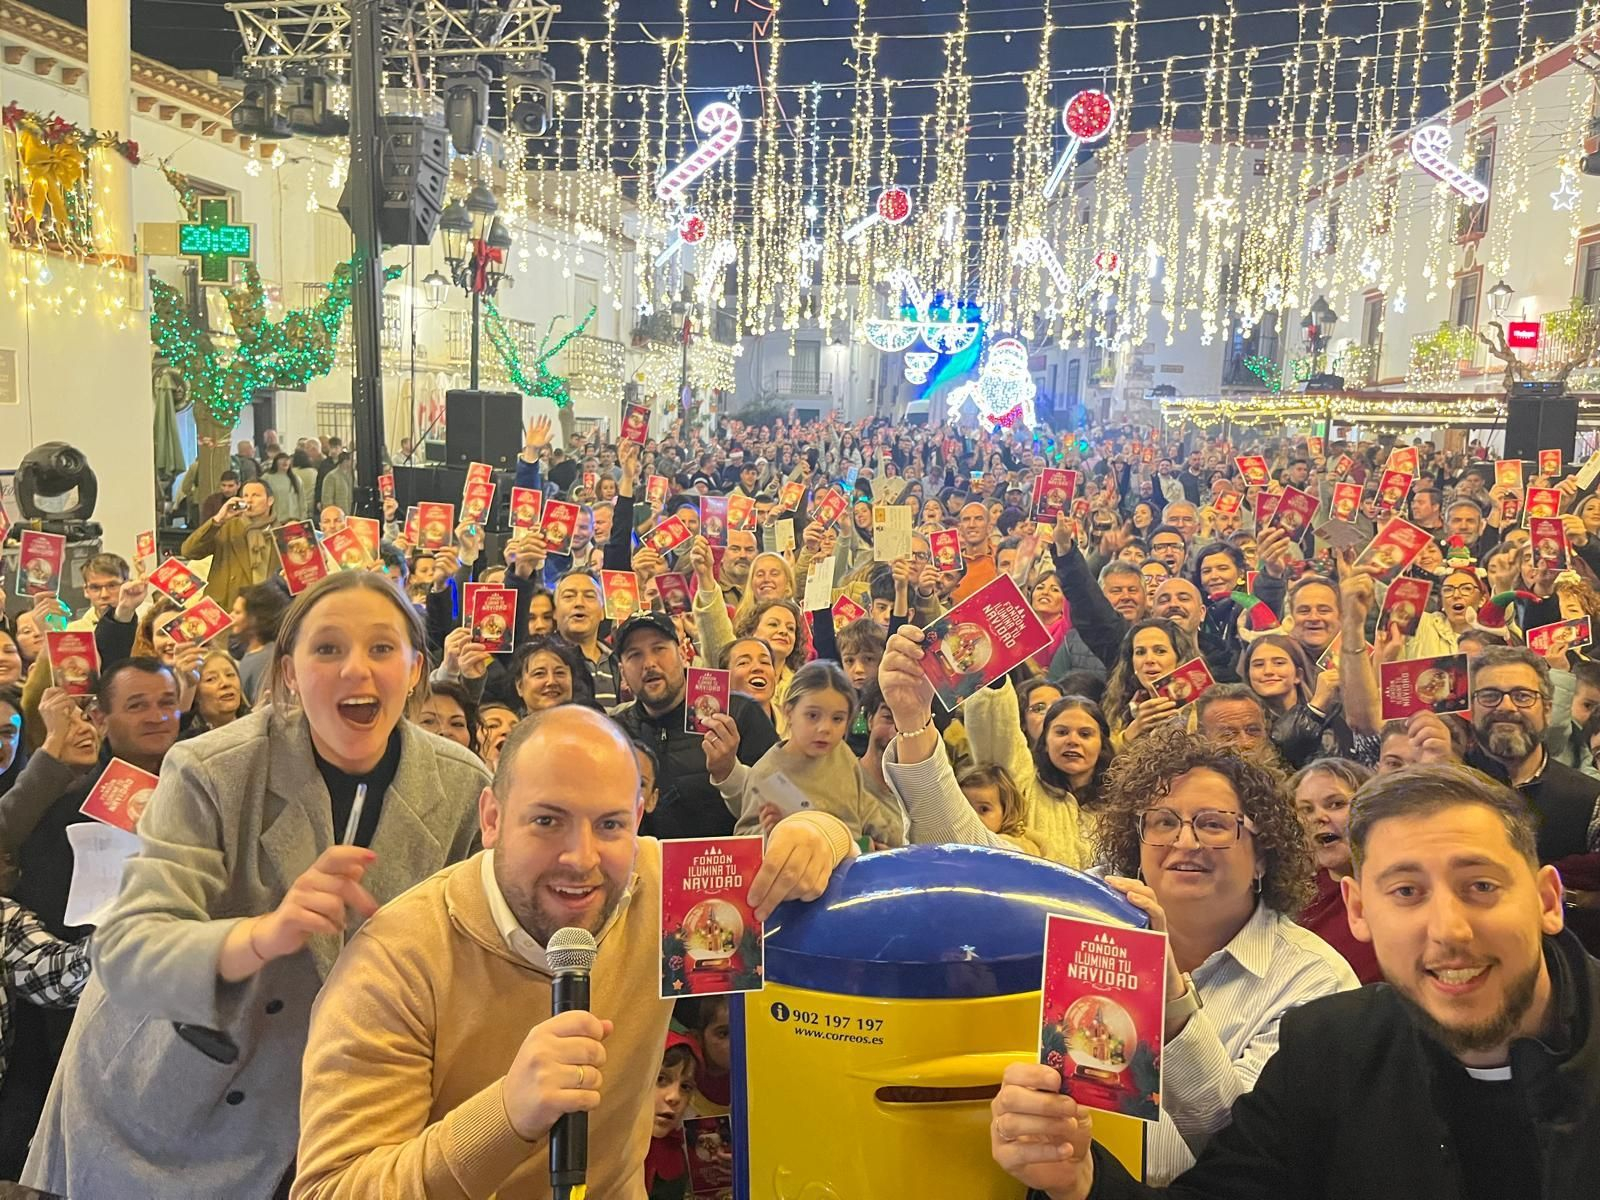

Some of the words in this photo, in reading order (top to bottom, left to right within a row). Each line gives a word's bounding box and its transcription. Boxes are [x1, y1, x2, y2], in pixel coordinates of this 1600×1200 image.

[182, 226, 249, 252] 20:50
[982, 604, 1016, 648] NAVIDAD
[1010, 627, 1022, 639] TU
[688, 864, 723, 877] ILUMINA
[725, 864, 737, 875] TU
[683, 875, 743, 891] NAVIDAD
[1074, 951, 1115, 971] ILUMINA
[1119, 960, 1132, 973] TU
[1068, 963, 1138, 990] NAVIDAD
[793, 1009, 819, 1025] 902
[824, 1015, 851, 1029] 197
[857, 1018, 884, 1032] 197
[794, 1027, 884, 1045] www.correos.es
